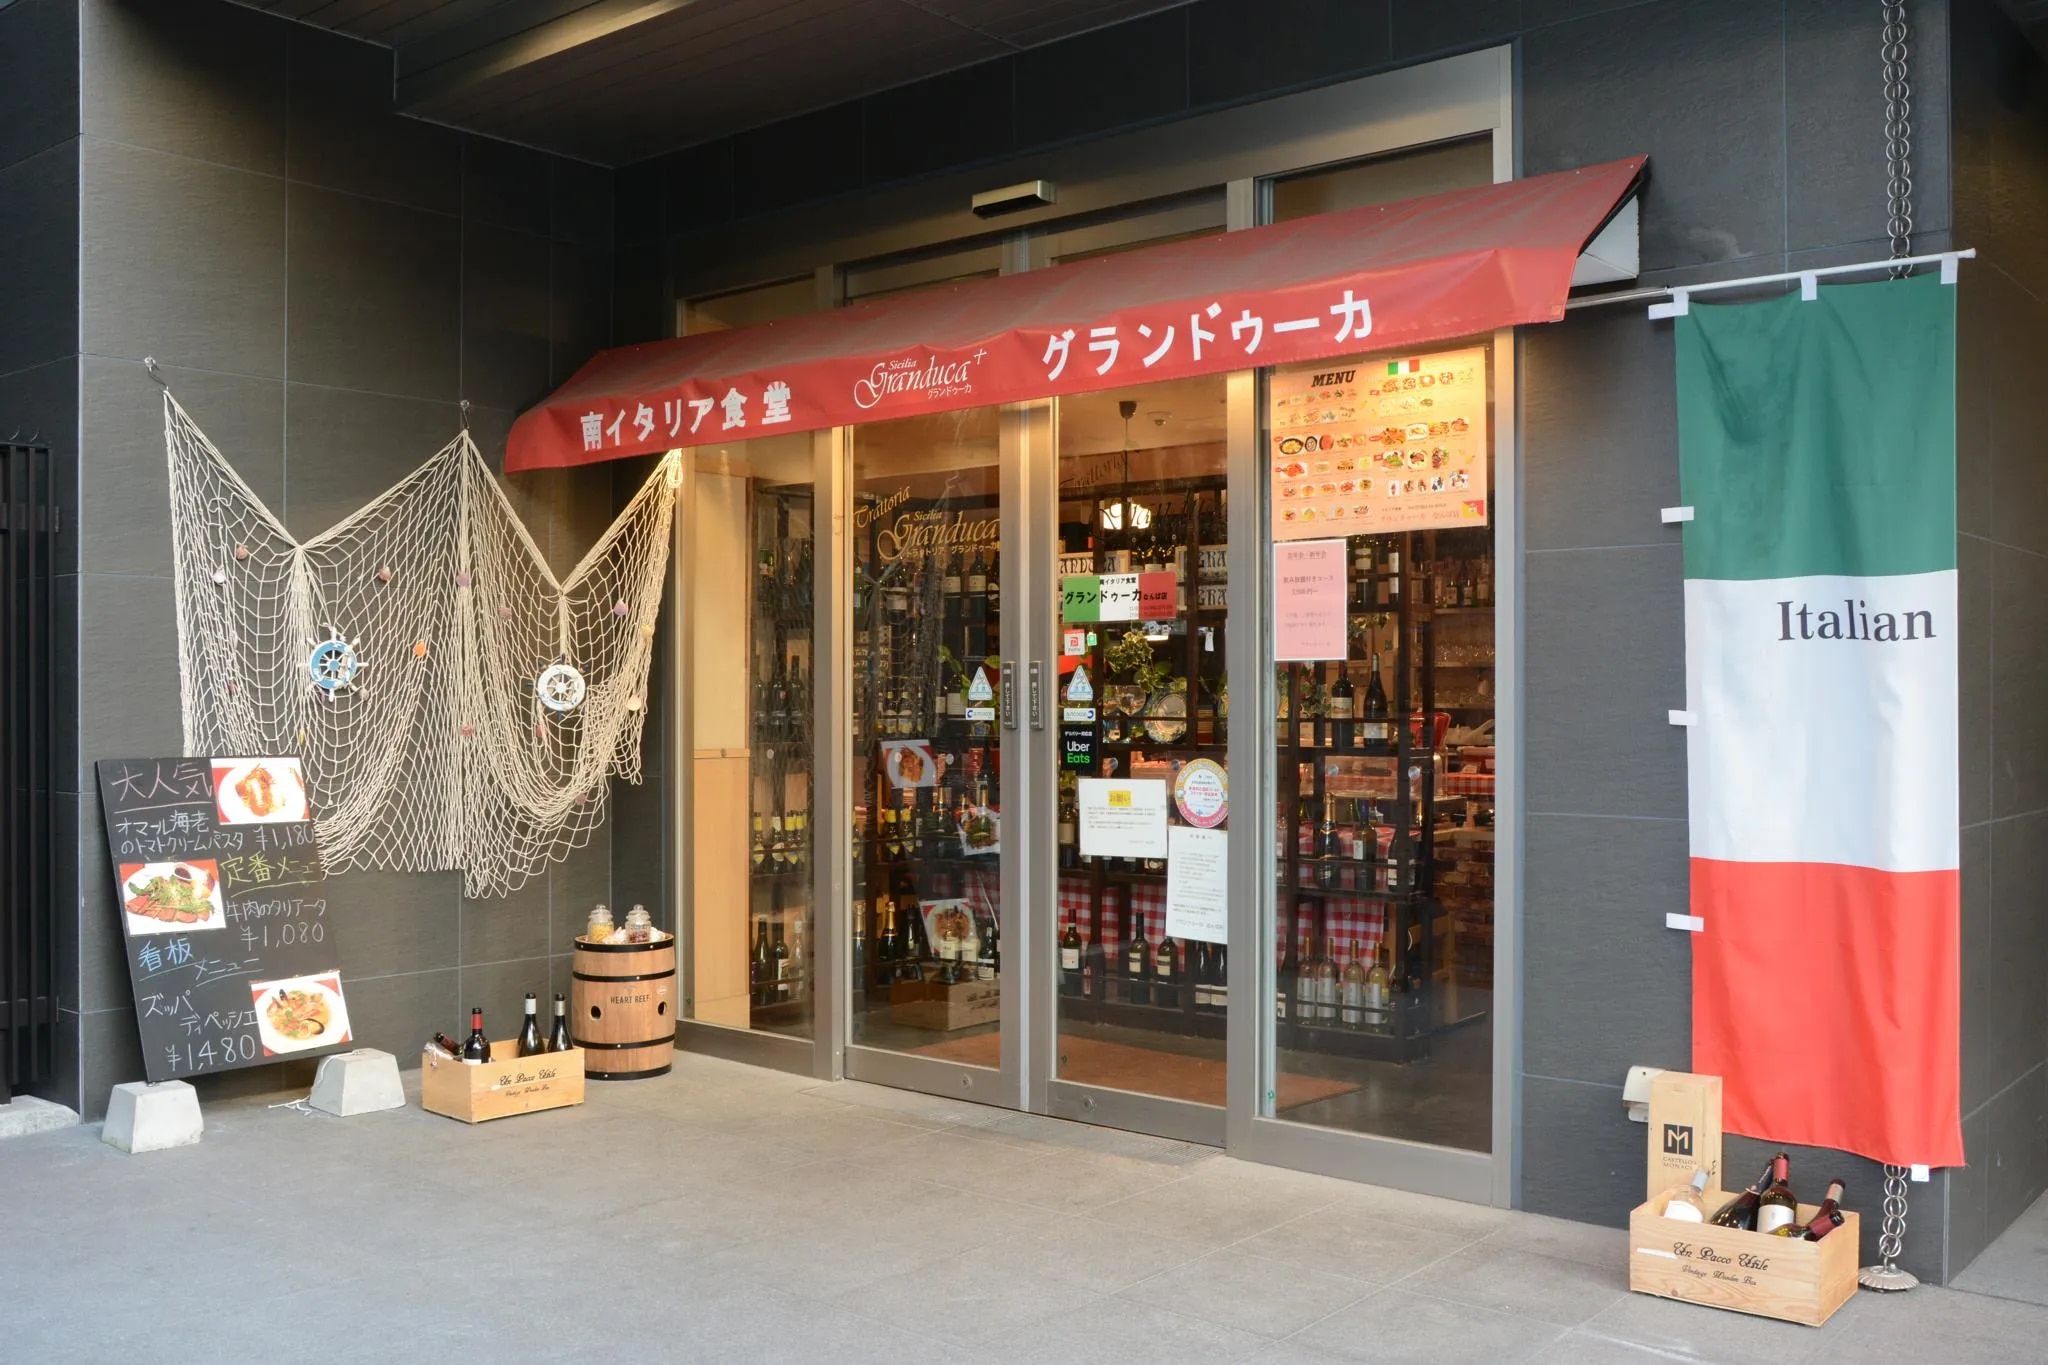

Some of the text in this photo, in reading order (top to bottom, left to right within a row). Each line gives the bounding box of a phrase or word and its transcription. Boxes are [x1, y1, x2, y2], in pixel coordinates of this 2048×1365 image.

[1042, 290, 1373, 381] グランドゥーカ
[888, 358, 917, 370] Sicilia
[854, 355, 971, 408] Granduca
[927, 383, 972, 399] グランドゥーカ
[1311, 370, 1356, 387] MENU
[580, 381, 791, 451] 南イタリア食堂
[853, 486, 911, 528] Trattoria
[913, 509, 943, 521] Sicilia
[877, 510, 1000, 560] Granduca
[1065, 588, 1168, 604] グランドゥーカ なんば店
[1776, 599, 1937, 642] Italian
[1067, 741, 1090, 752] Uber
[1067, 753, 1090, 764] Eats
[112, 762, 213, 801] 大人気
[116, 810, 209, 835] オマール海老
[121, 830, 243, 854] のトマトクリームパスタ
[253, 825, 315, 851] ¥1,180
[220, 850, 317, 888] 定番メニュー
[240, 921, 324, 952] ¥1,080
[138, 938, 260, 981] 看板 メニュー
[142, 989, 194, 1018] ズッパ
[610, 996, 632, 1004] HEART
[165, 1034, 256, 1071] ¥1,480
[1696, 1246, 1732, 1265] Pacco
